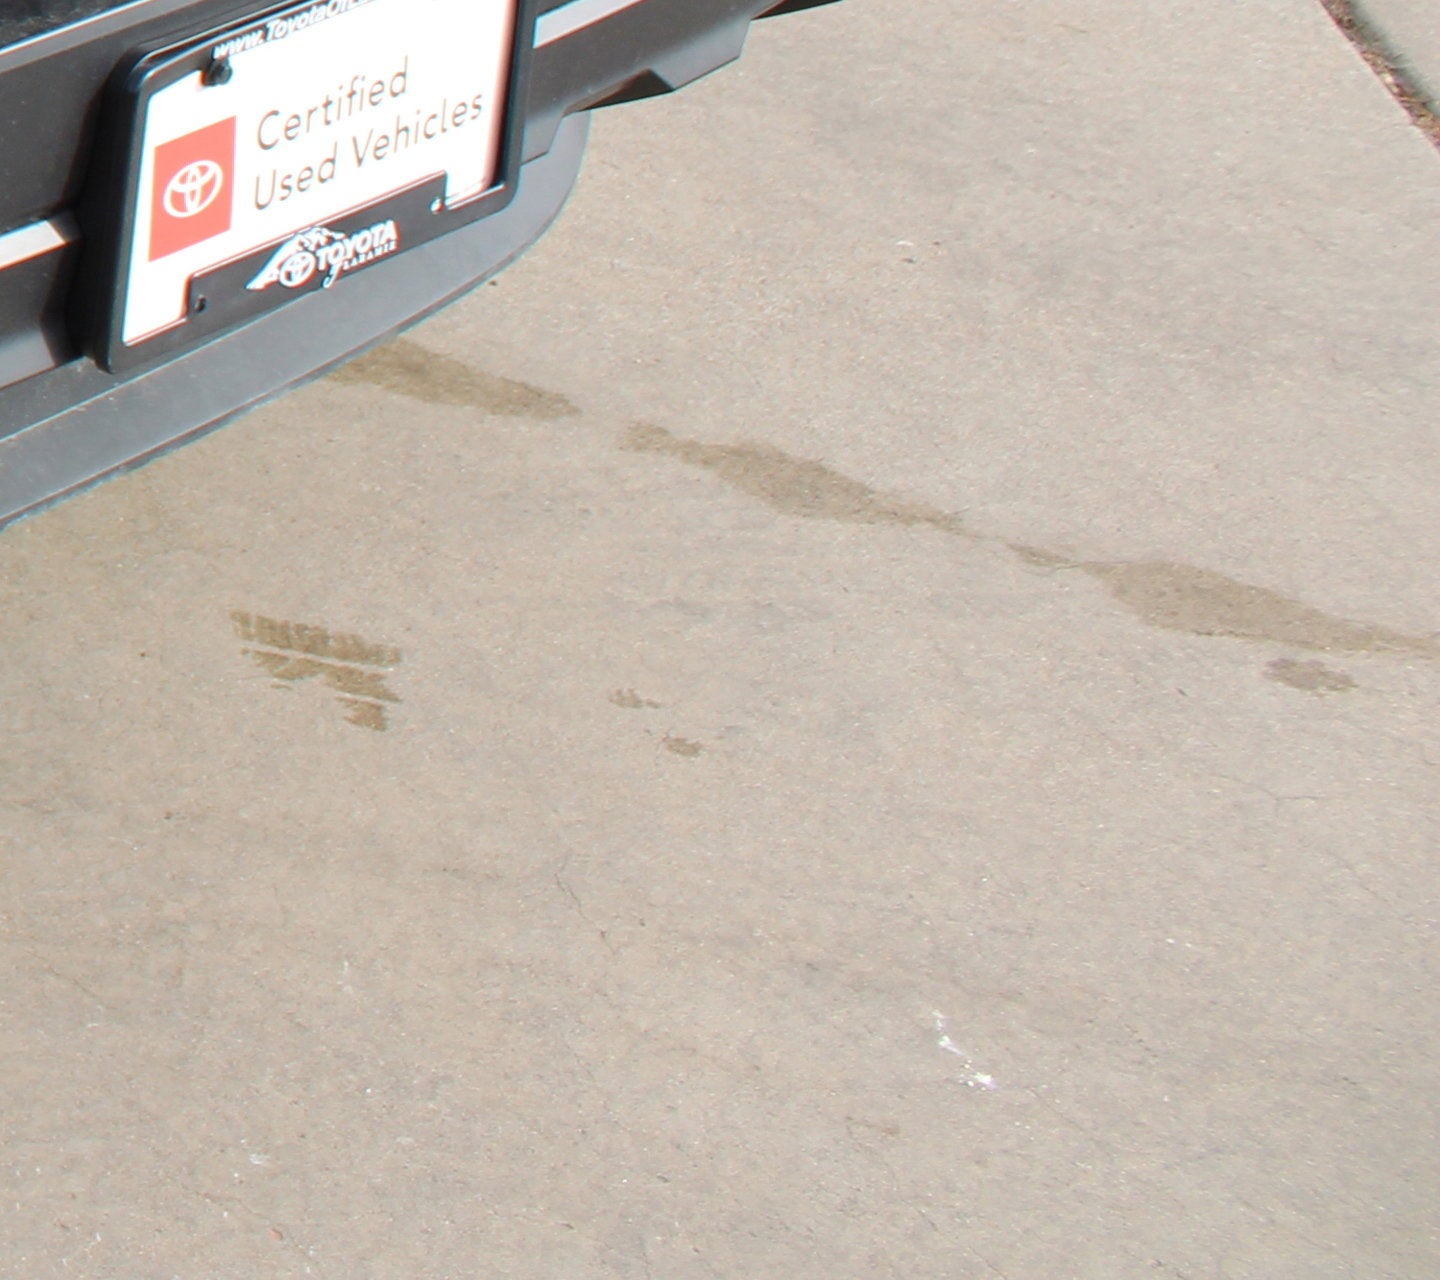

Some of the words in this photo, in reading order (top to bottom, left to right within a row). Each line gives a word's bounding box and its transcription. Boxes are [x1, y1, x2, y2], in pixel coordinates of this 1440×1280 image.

[257, 55, 408, 150] Certified
[255, 141, 338, 210] Used
[352, 94, 483, 168] Vehicles
[315, 219, 398, 272] TOYOTA
